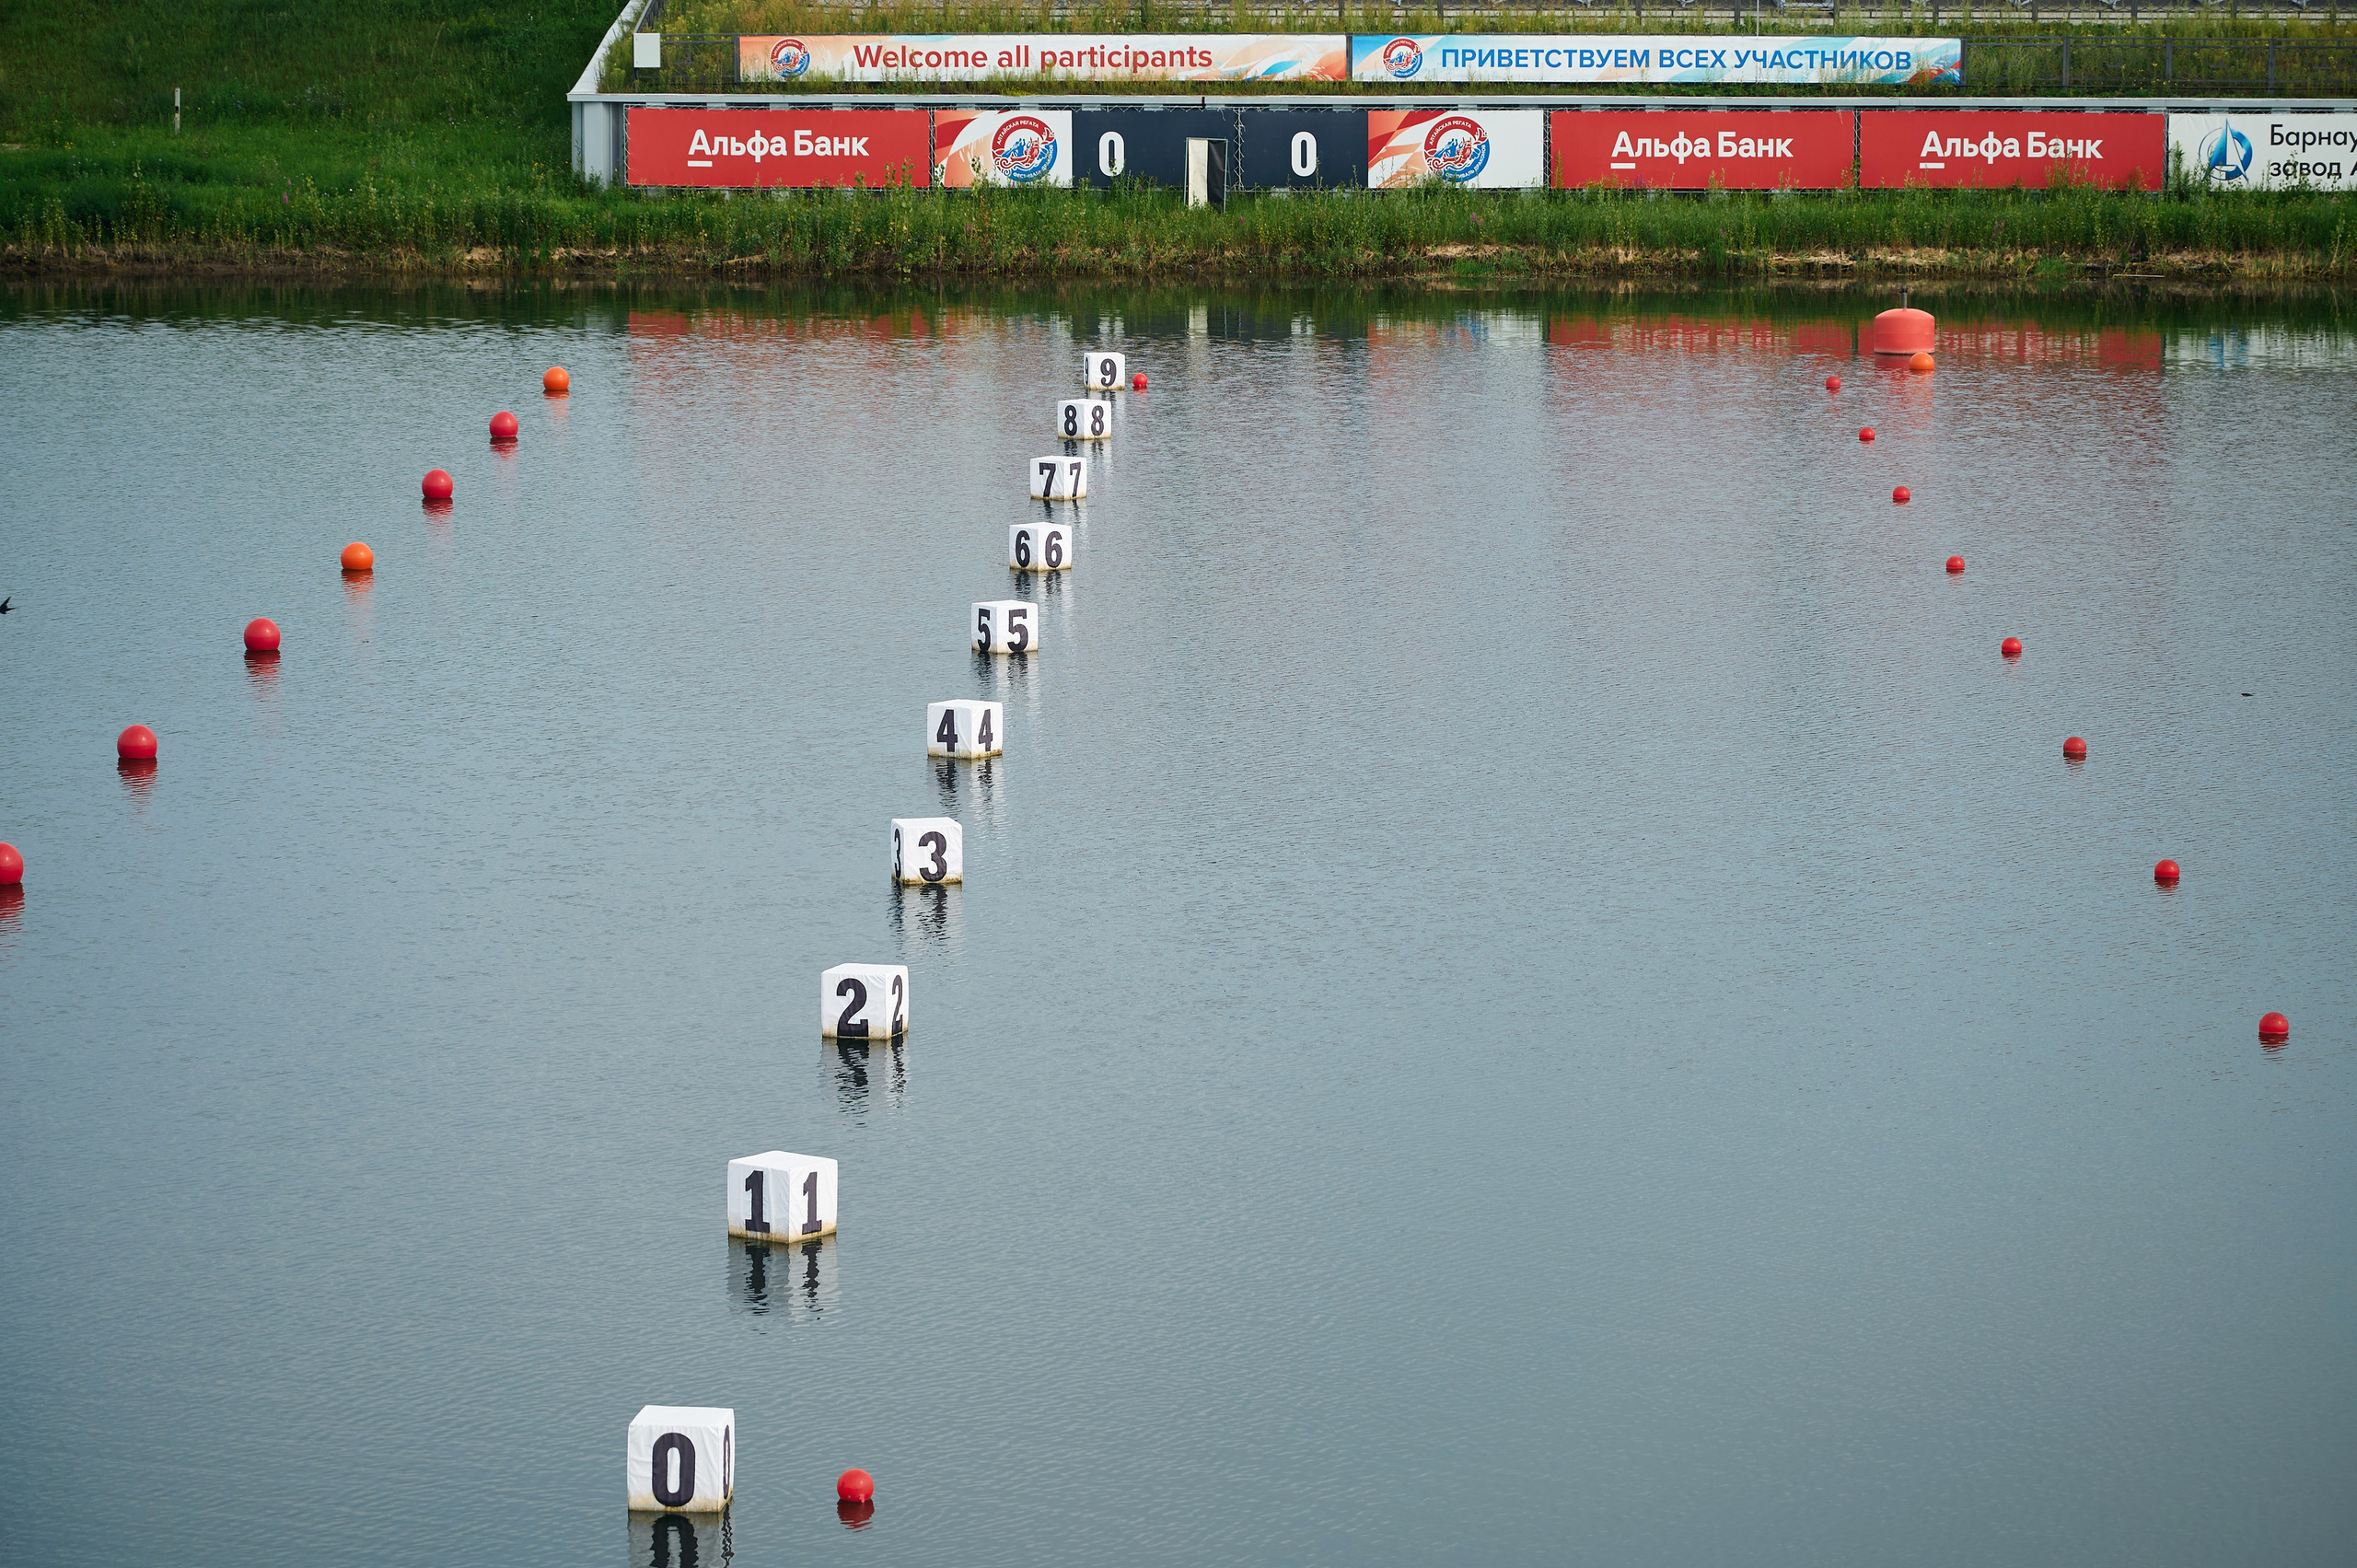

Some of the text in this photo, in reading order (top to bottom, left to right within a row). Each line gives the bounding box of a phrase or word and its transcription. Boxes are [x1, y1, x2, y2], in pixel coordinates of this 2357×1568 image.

[853, 44, 1213, 73] Welcome all participants
[1442, 49, 1650, 68] ПРИВЕТСТВУЕМ
[1659, 49, 1726, 69] ВСЕХ
[1734, 50, 1911, 70] УЧАСТНИКОВ
[688, 129, 869, 163] Альфа Банк
[997, 120, 1039, 145] АЛТАЙСКАЯ РЕГАТА
[1429, 120, 1471, 145] АЛТАЙСКАЯ РЕГАТА
[1611, 131, 1794, 164] Альфа Банк
[1920, 131, 2103, 164] Альфа Банк
[1098, 131, 1125, 177] 0
[1291, 131, 1318, 177] 0
[2270, 162, 2341, 179] завод
[1100, 358, 1117, 387] 9
[1064, 405, 1077, 436] 8
[1091, 405, 1104, 436] 8
[1039, 462, 1056, 497] 7
[1070, 462, 1081, 497] 7
[1015, 530, 1030, 567] 6
[1045, 530, 1062, 568] 6
[978, 608, 991, 651] 5
[1007, 609, 1028, 651] 5
[936, 709, 958, 752] 4
[978, 709, 993, 751] 4
[894, 829, 901, 878] 3
[918, 831, 947, 881] 3
[836, 978, 868, 1037] 2
[891, 974, 903, 1035] 2
[745, 1169, 770, 1233] 1
[802, 1171, 822, 1235] 1
[652, 1433, 695, 1507] 0
